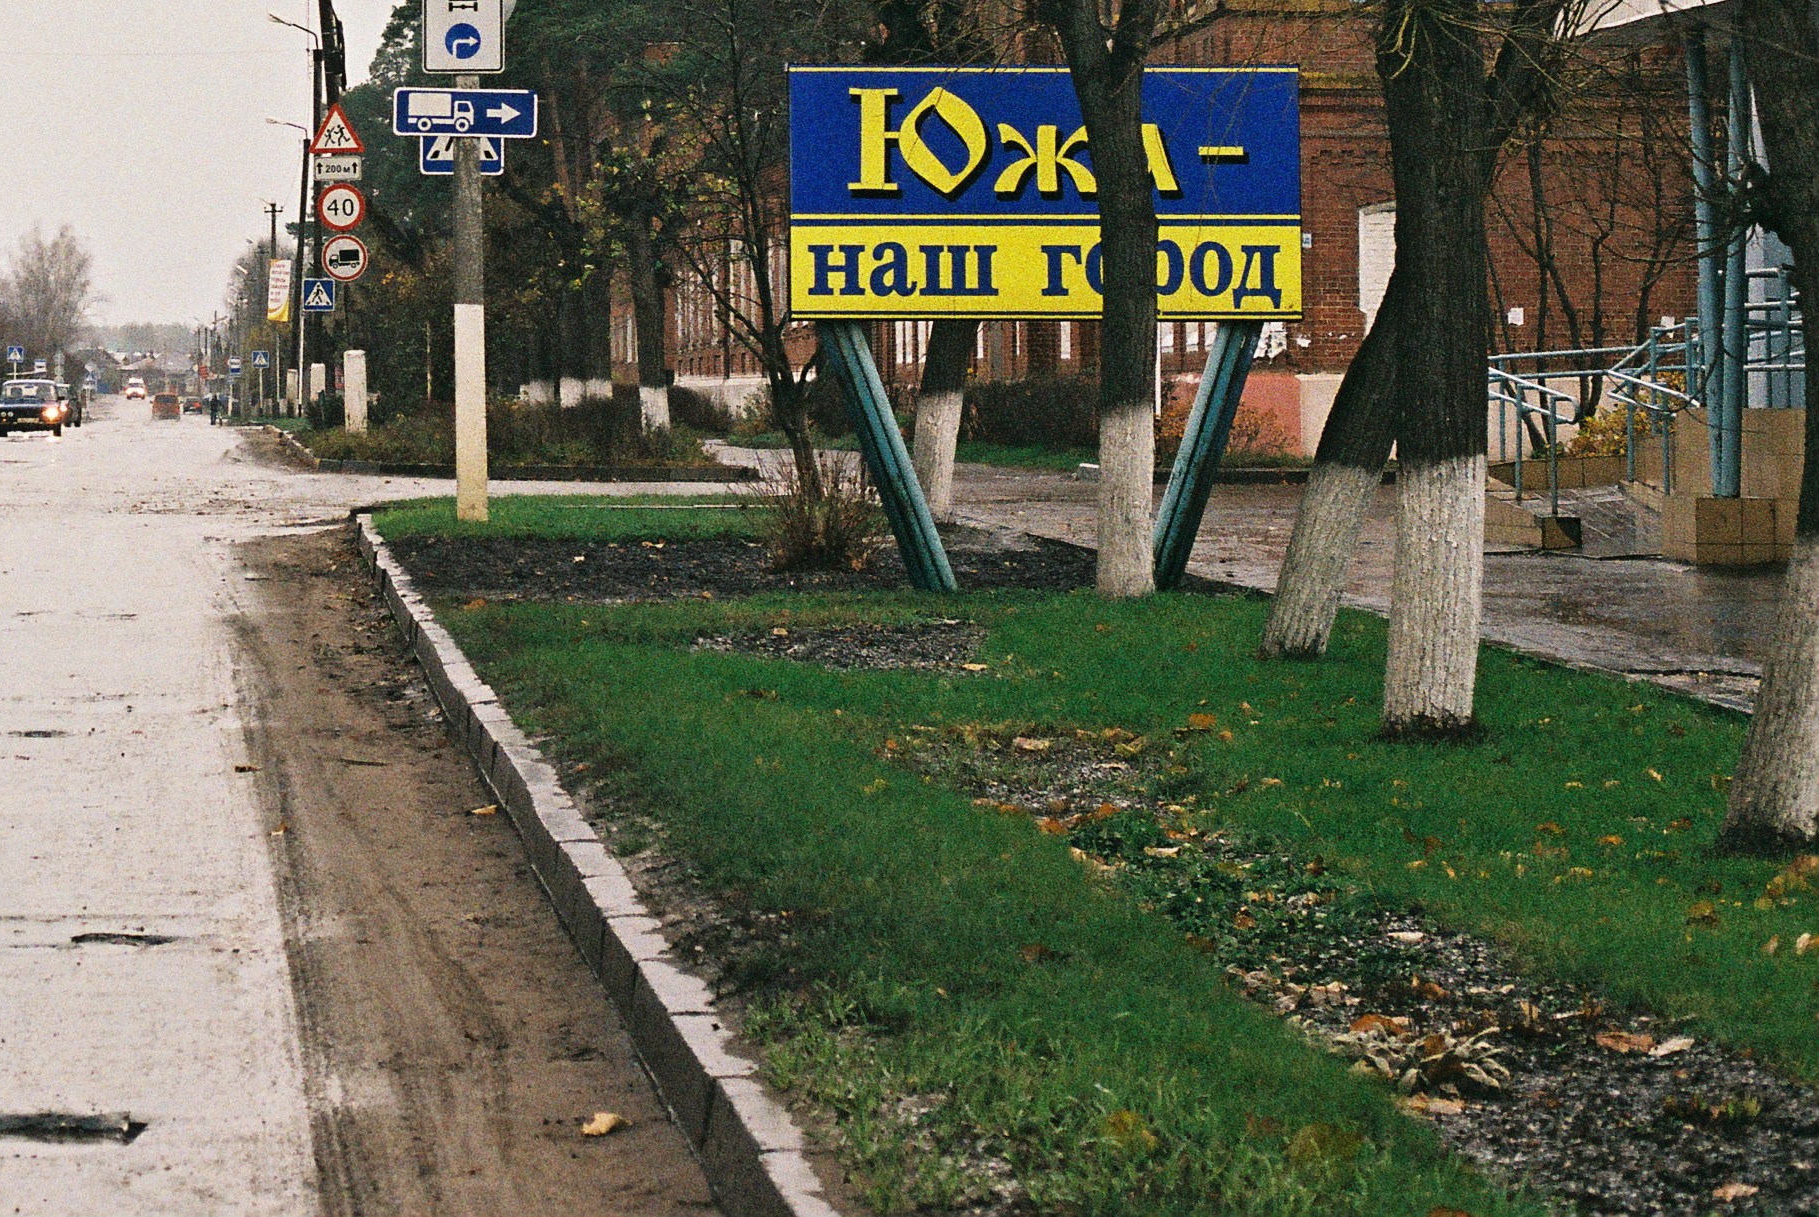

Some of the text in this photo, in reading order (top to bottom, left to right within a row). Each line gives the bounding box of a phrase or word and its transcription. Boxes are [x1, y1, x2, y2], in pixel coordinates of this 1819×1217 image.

[325, 165, 342, 173] 200
[327, 199, 354, 216] 40
[807, 239, 999, 297] наш
